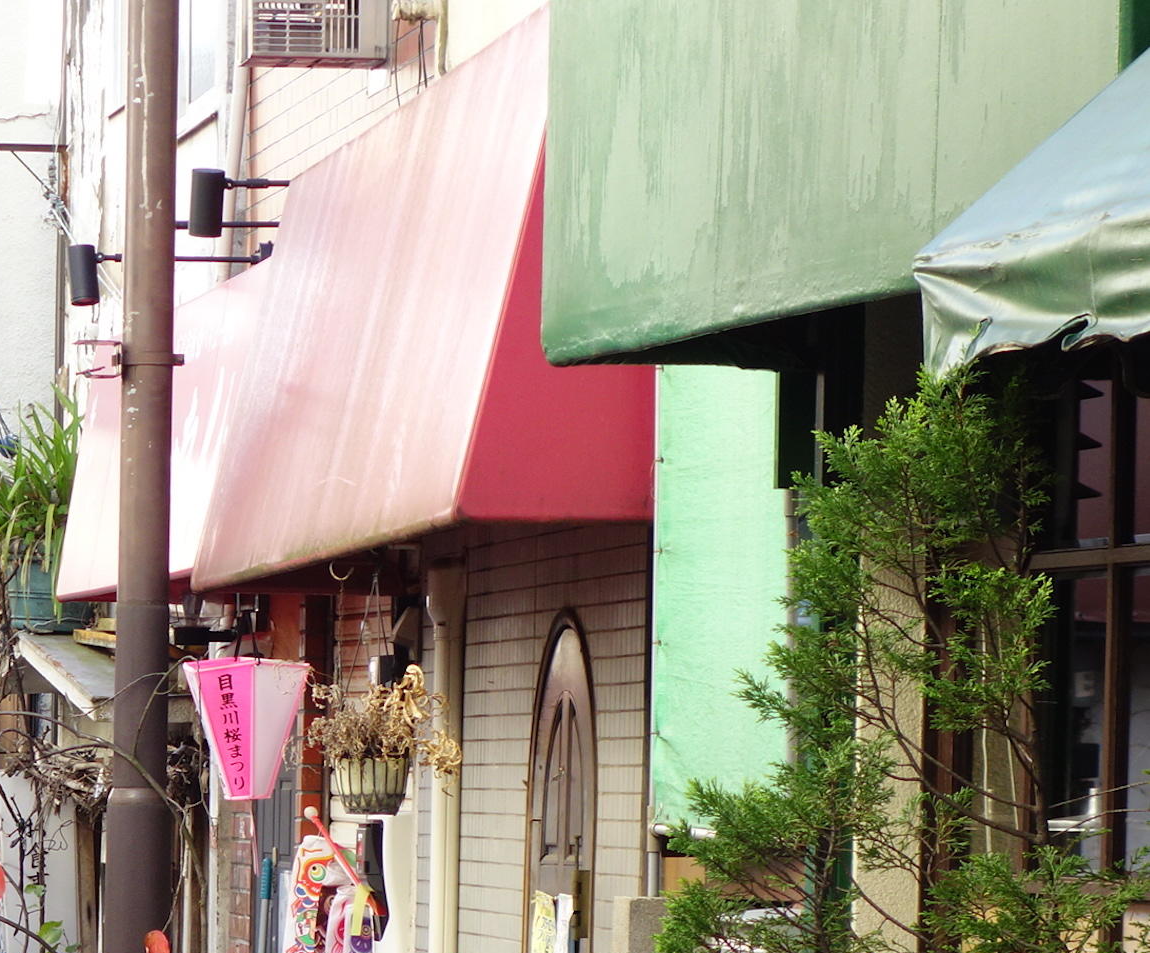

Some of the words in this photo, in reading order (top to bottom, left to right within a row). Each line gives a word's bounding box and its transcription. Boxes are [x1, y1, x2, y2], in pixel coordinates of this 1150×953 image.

[217, 673, 246, 790] 目黒川桜まつり
